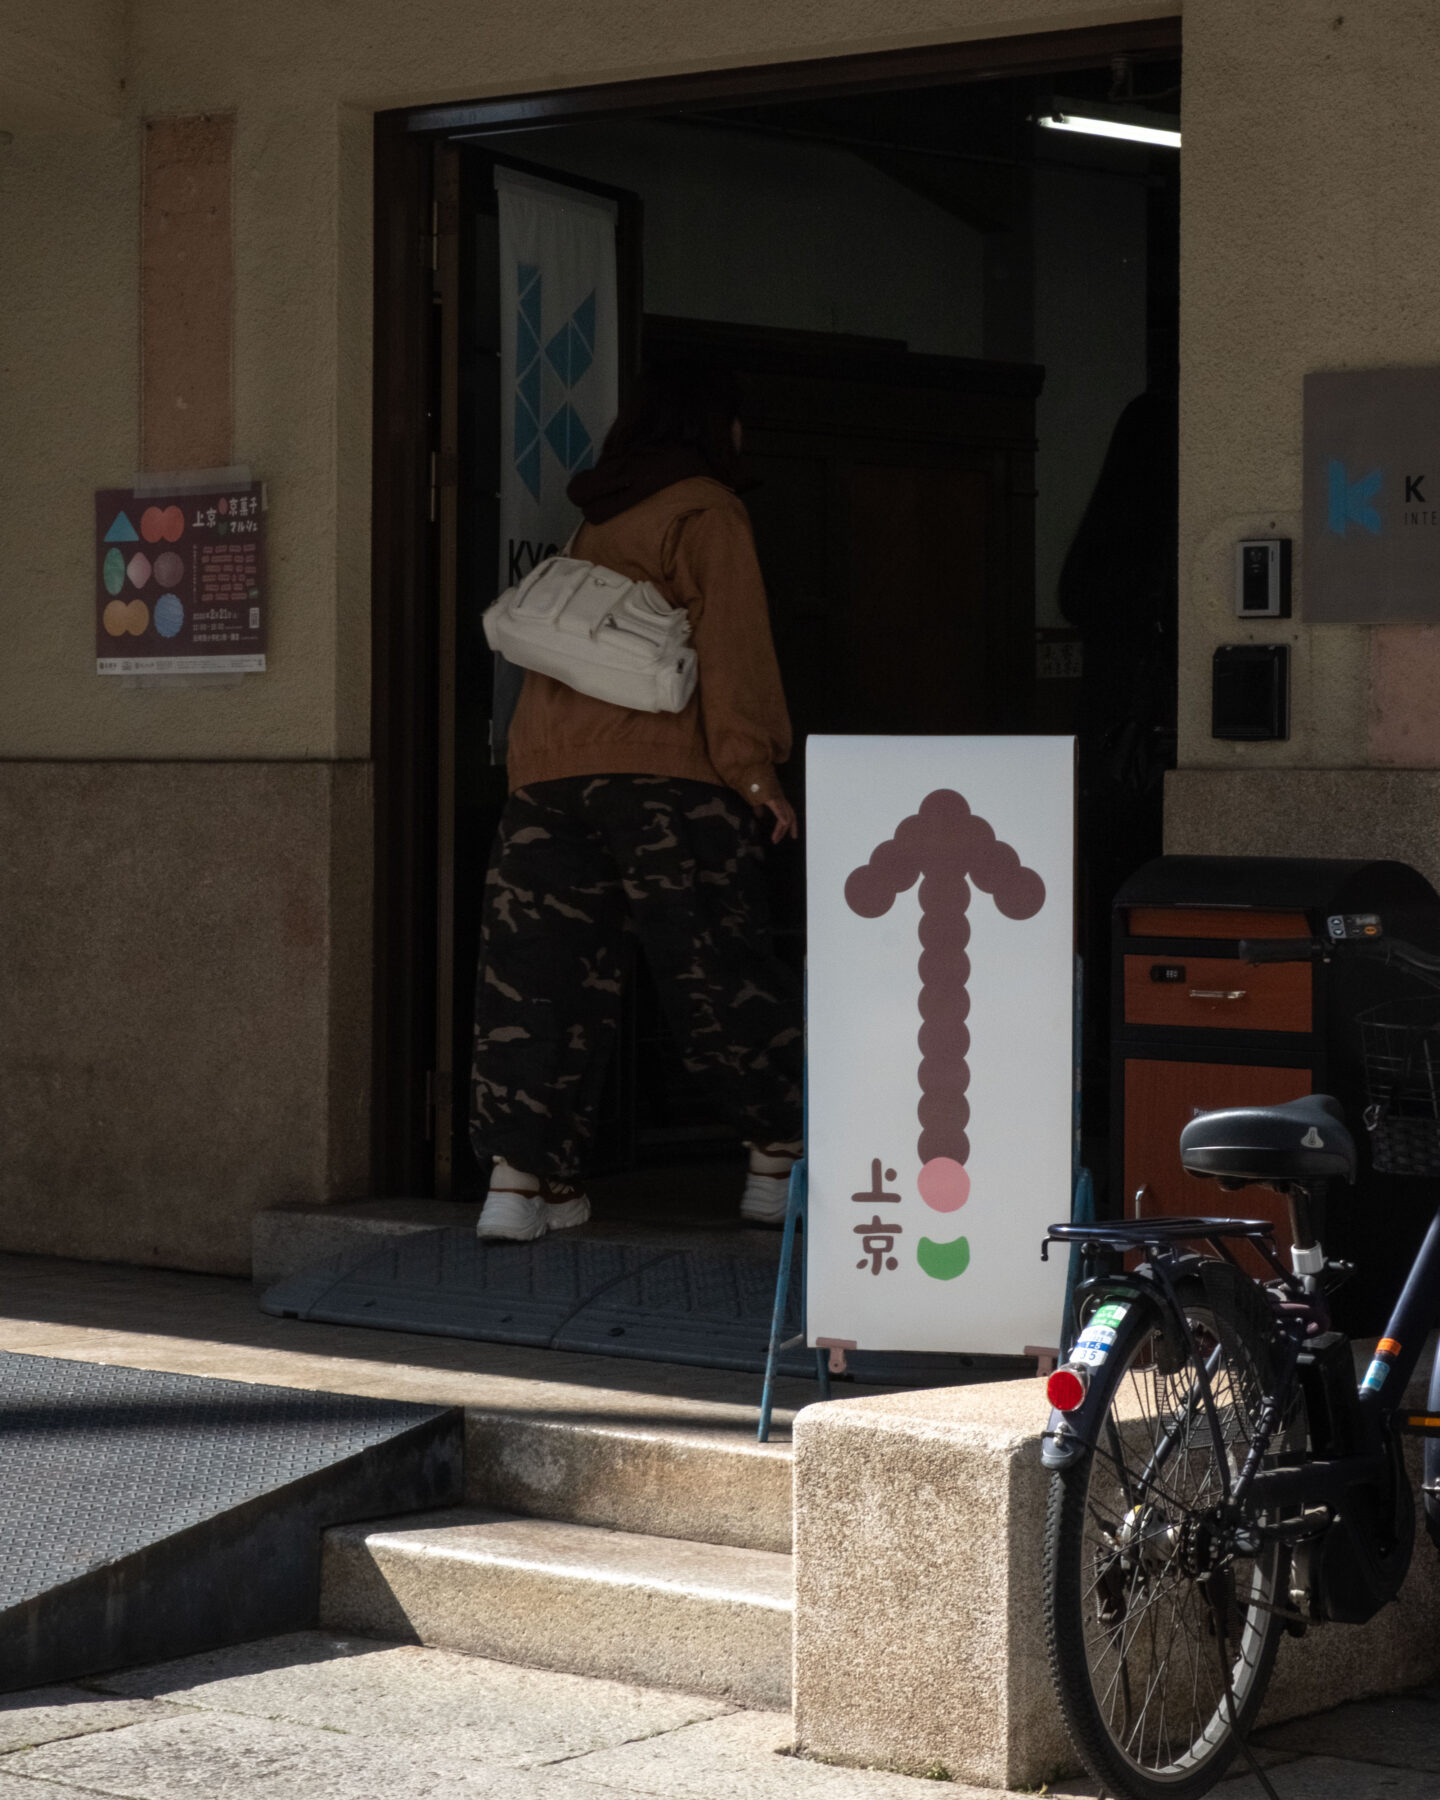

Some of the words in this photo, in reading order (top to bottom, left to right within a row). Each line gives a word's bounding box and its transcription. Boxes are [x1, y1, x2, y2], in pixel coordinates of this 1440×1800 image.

[1404, 475, 1426, 503] K
[192, 507, 217, 528] 上京
[850, 1157, 903, 1276] 上京
